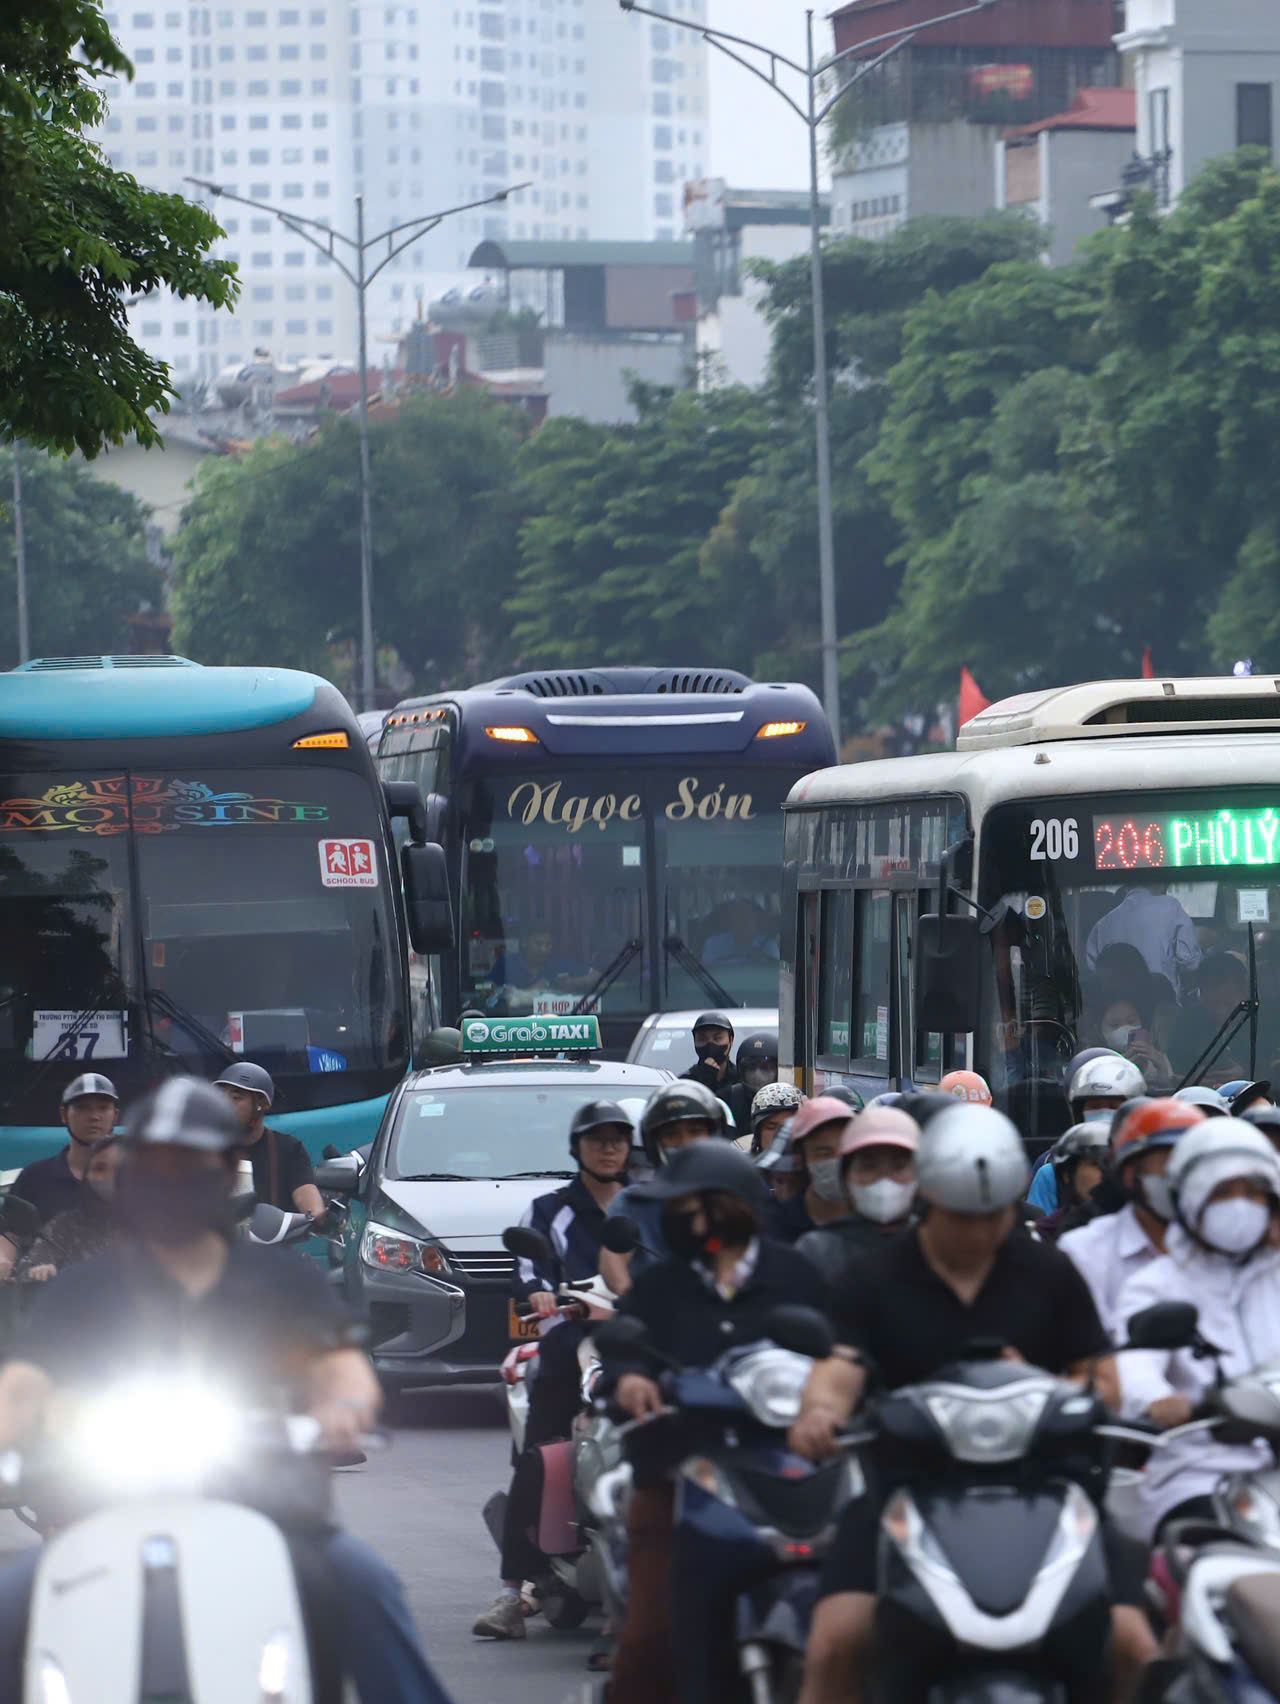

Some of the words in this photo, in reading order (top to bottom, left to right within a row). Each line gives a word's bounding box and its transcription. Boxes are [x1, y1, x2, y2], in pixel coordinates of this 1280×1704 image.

[507, 781, 642, 833] Ngọc
[1030, 818, 1079, 861] 206
[1096, 822, 1164, 868] 206
